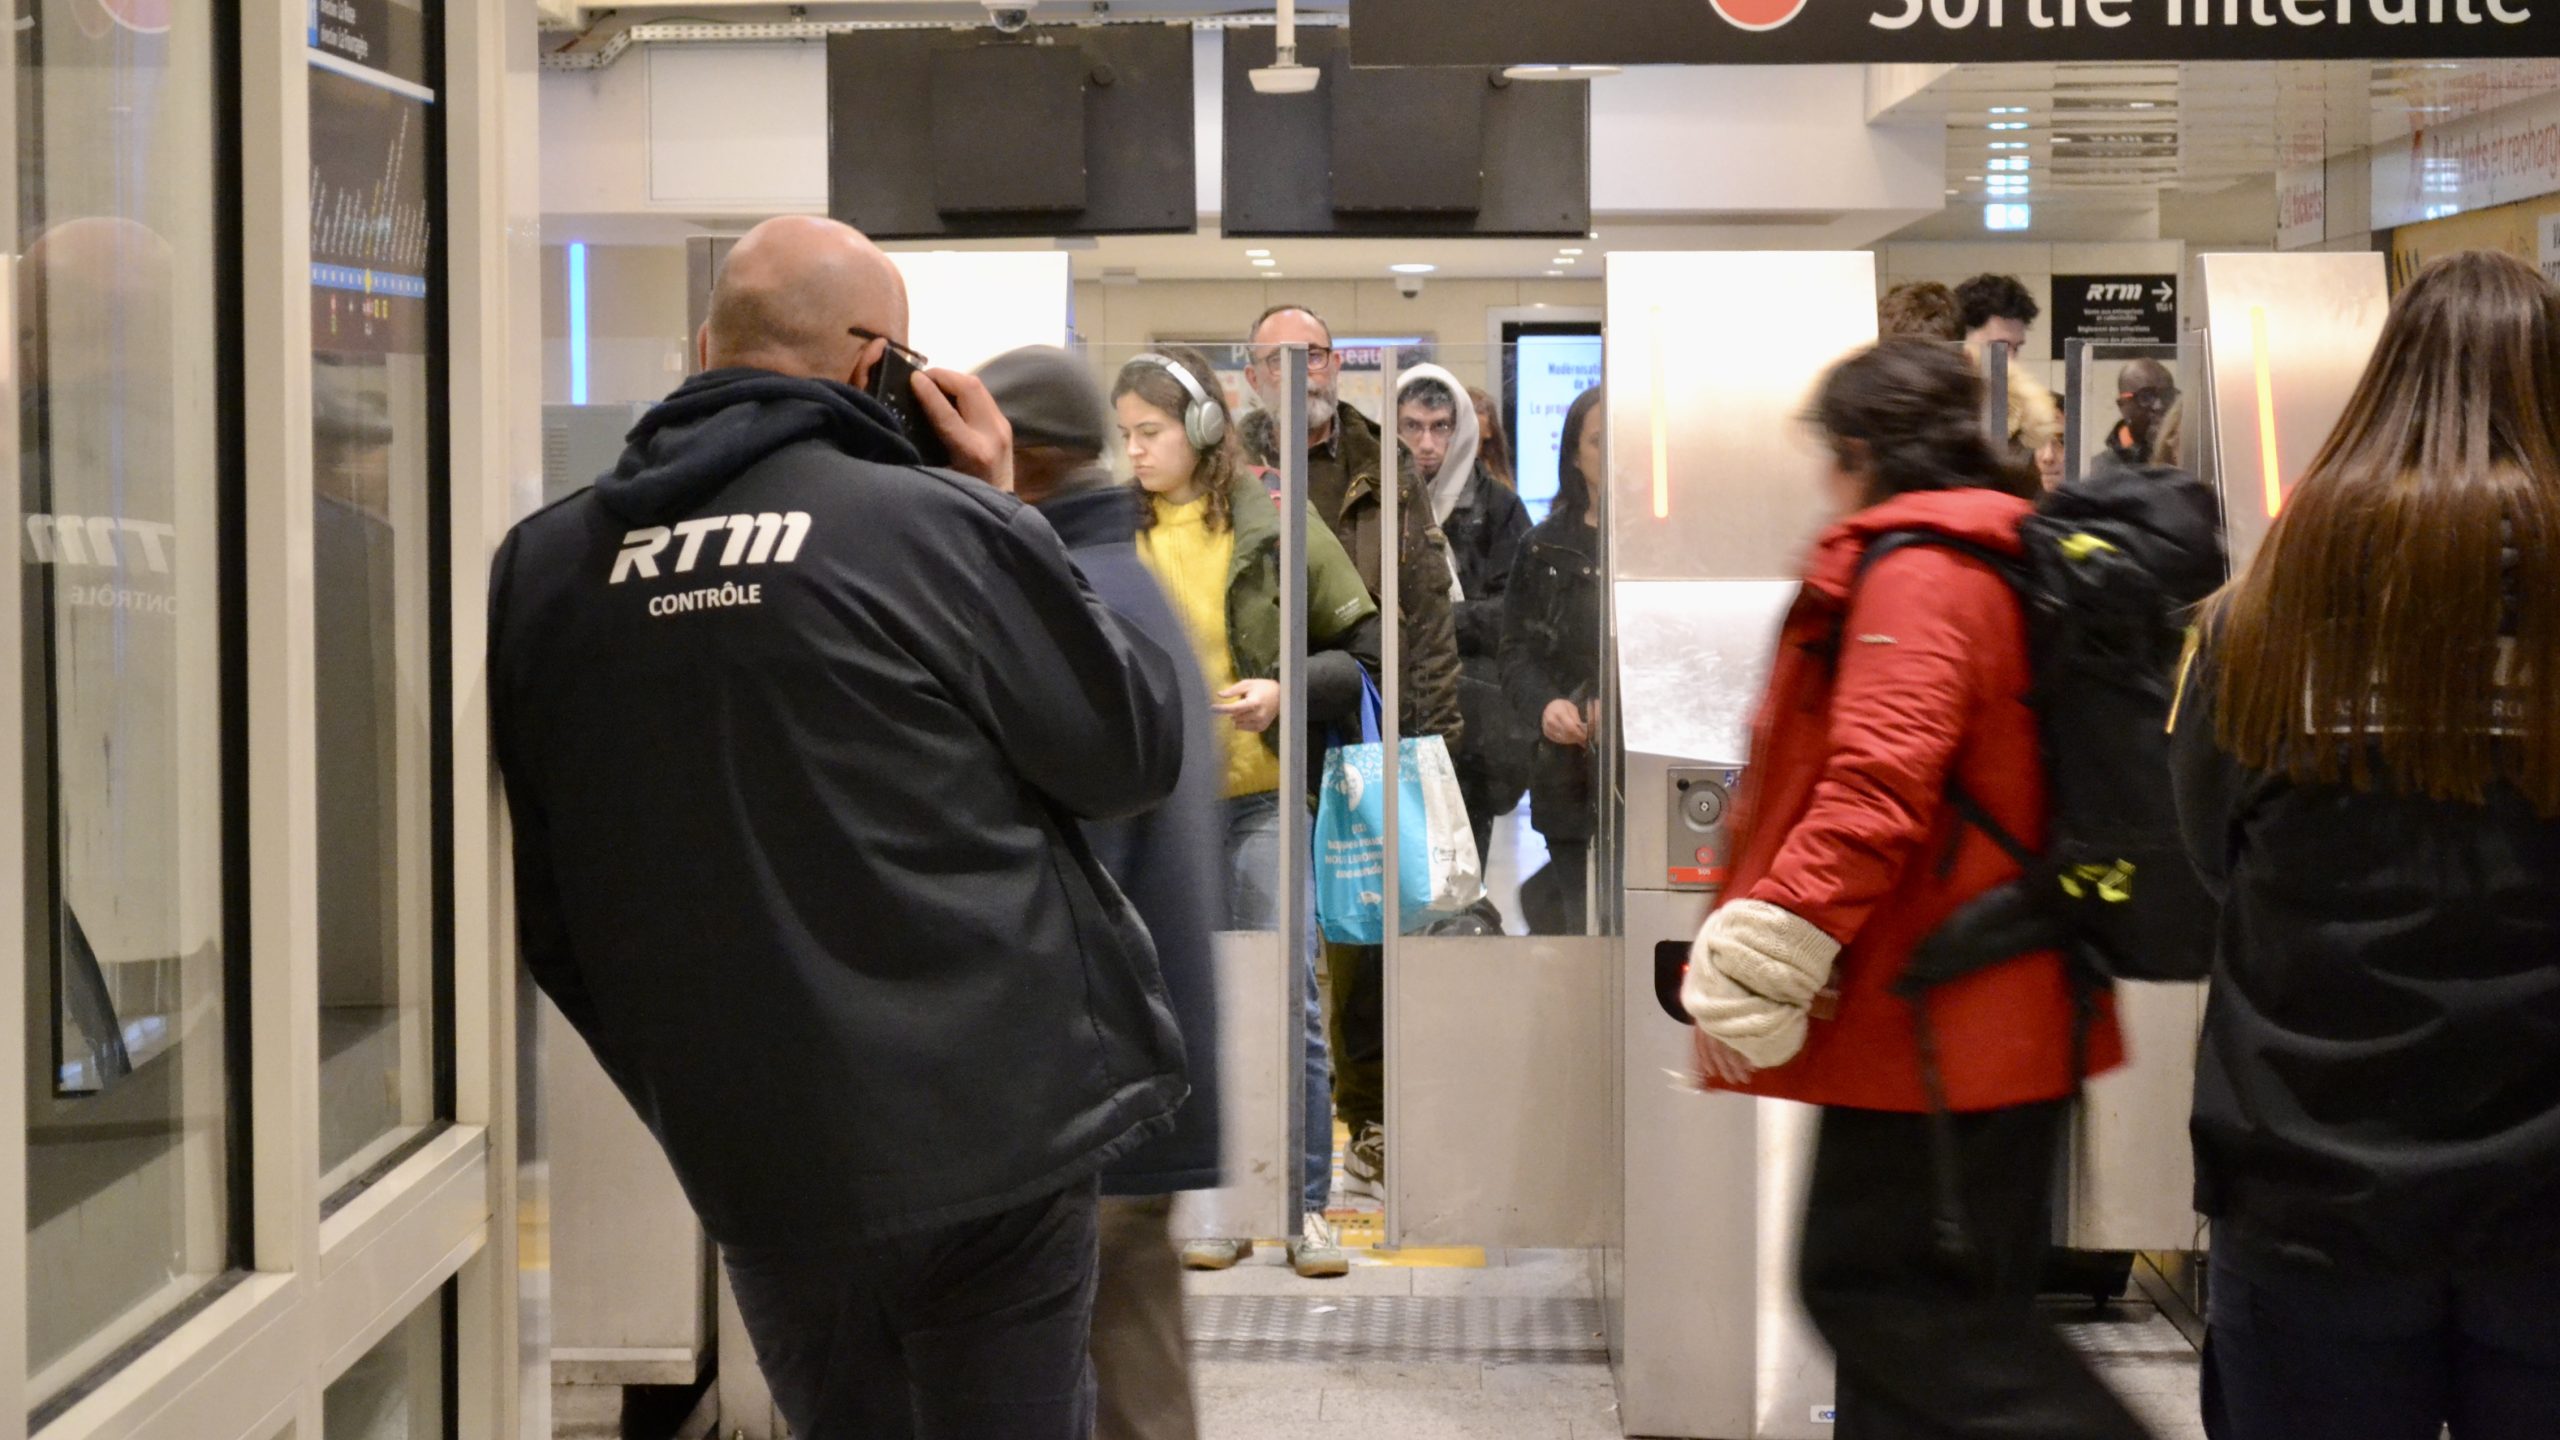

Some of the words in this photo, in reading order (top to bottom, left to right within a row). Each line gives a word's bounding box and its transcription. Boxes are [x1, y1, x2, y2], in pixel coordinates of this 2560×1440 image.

[2086, 283, 2143, 301] RTM
[609, 511, 812, 584] RTM
[649, 581, 762, 617] CONTRÔLE
[1698, 867, 1711, 876] SOS
